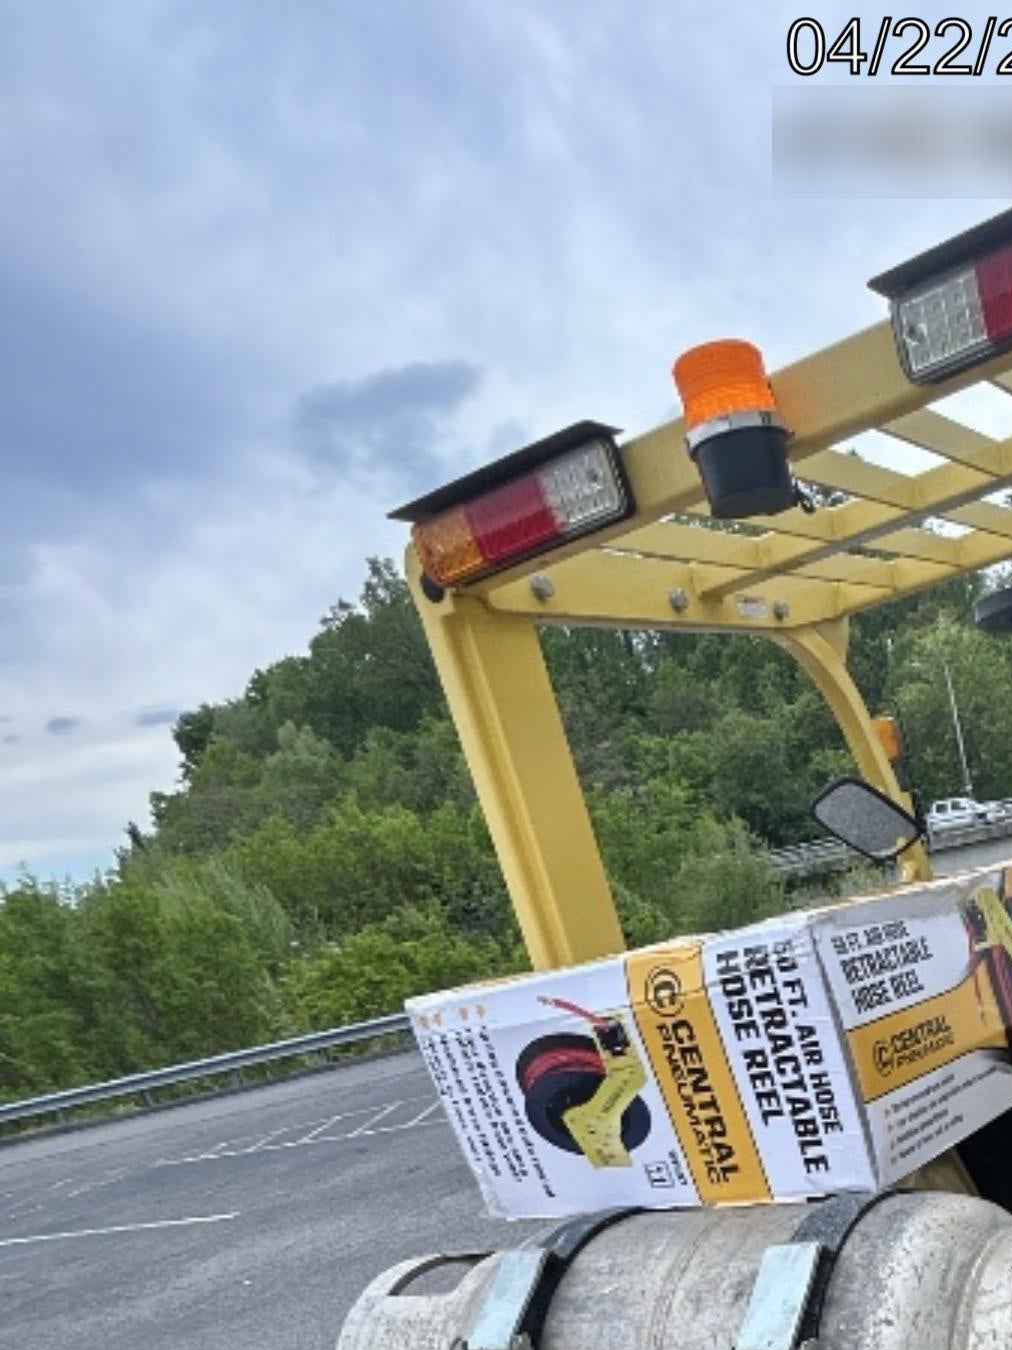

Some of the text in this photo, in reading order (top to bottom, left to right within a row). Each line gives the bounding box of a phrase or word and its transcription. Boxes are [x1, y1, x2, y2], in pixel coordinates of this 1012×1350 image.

[656, 1023, 723, 1185] PNEUMATIC
[671, 1018, 739, 1183] CENTRAL
[716, 949, 785, 1127] HOSE REEL
[743, 944, 829, 1174] RETRACTABLE
[781, 976, 808, 1018] FT.
[795, 1024, 822, 1067] AIR
[809, 1071, 843, 1136] HOSE
